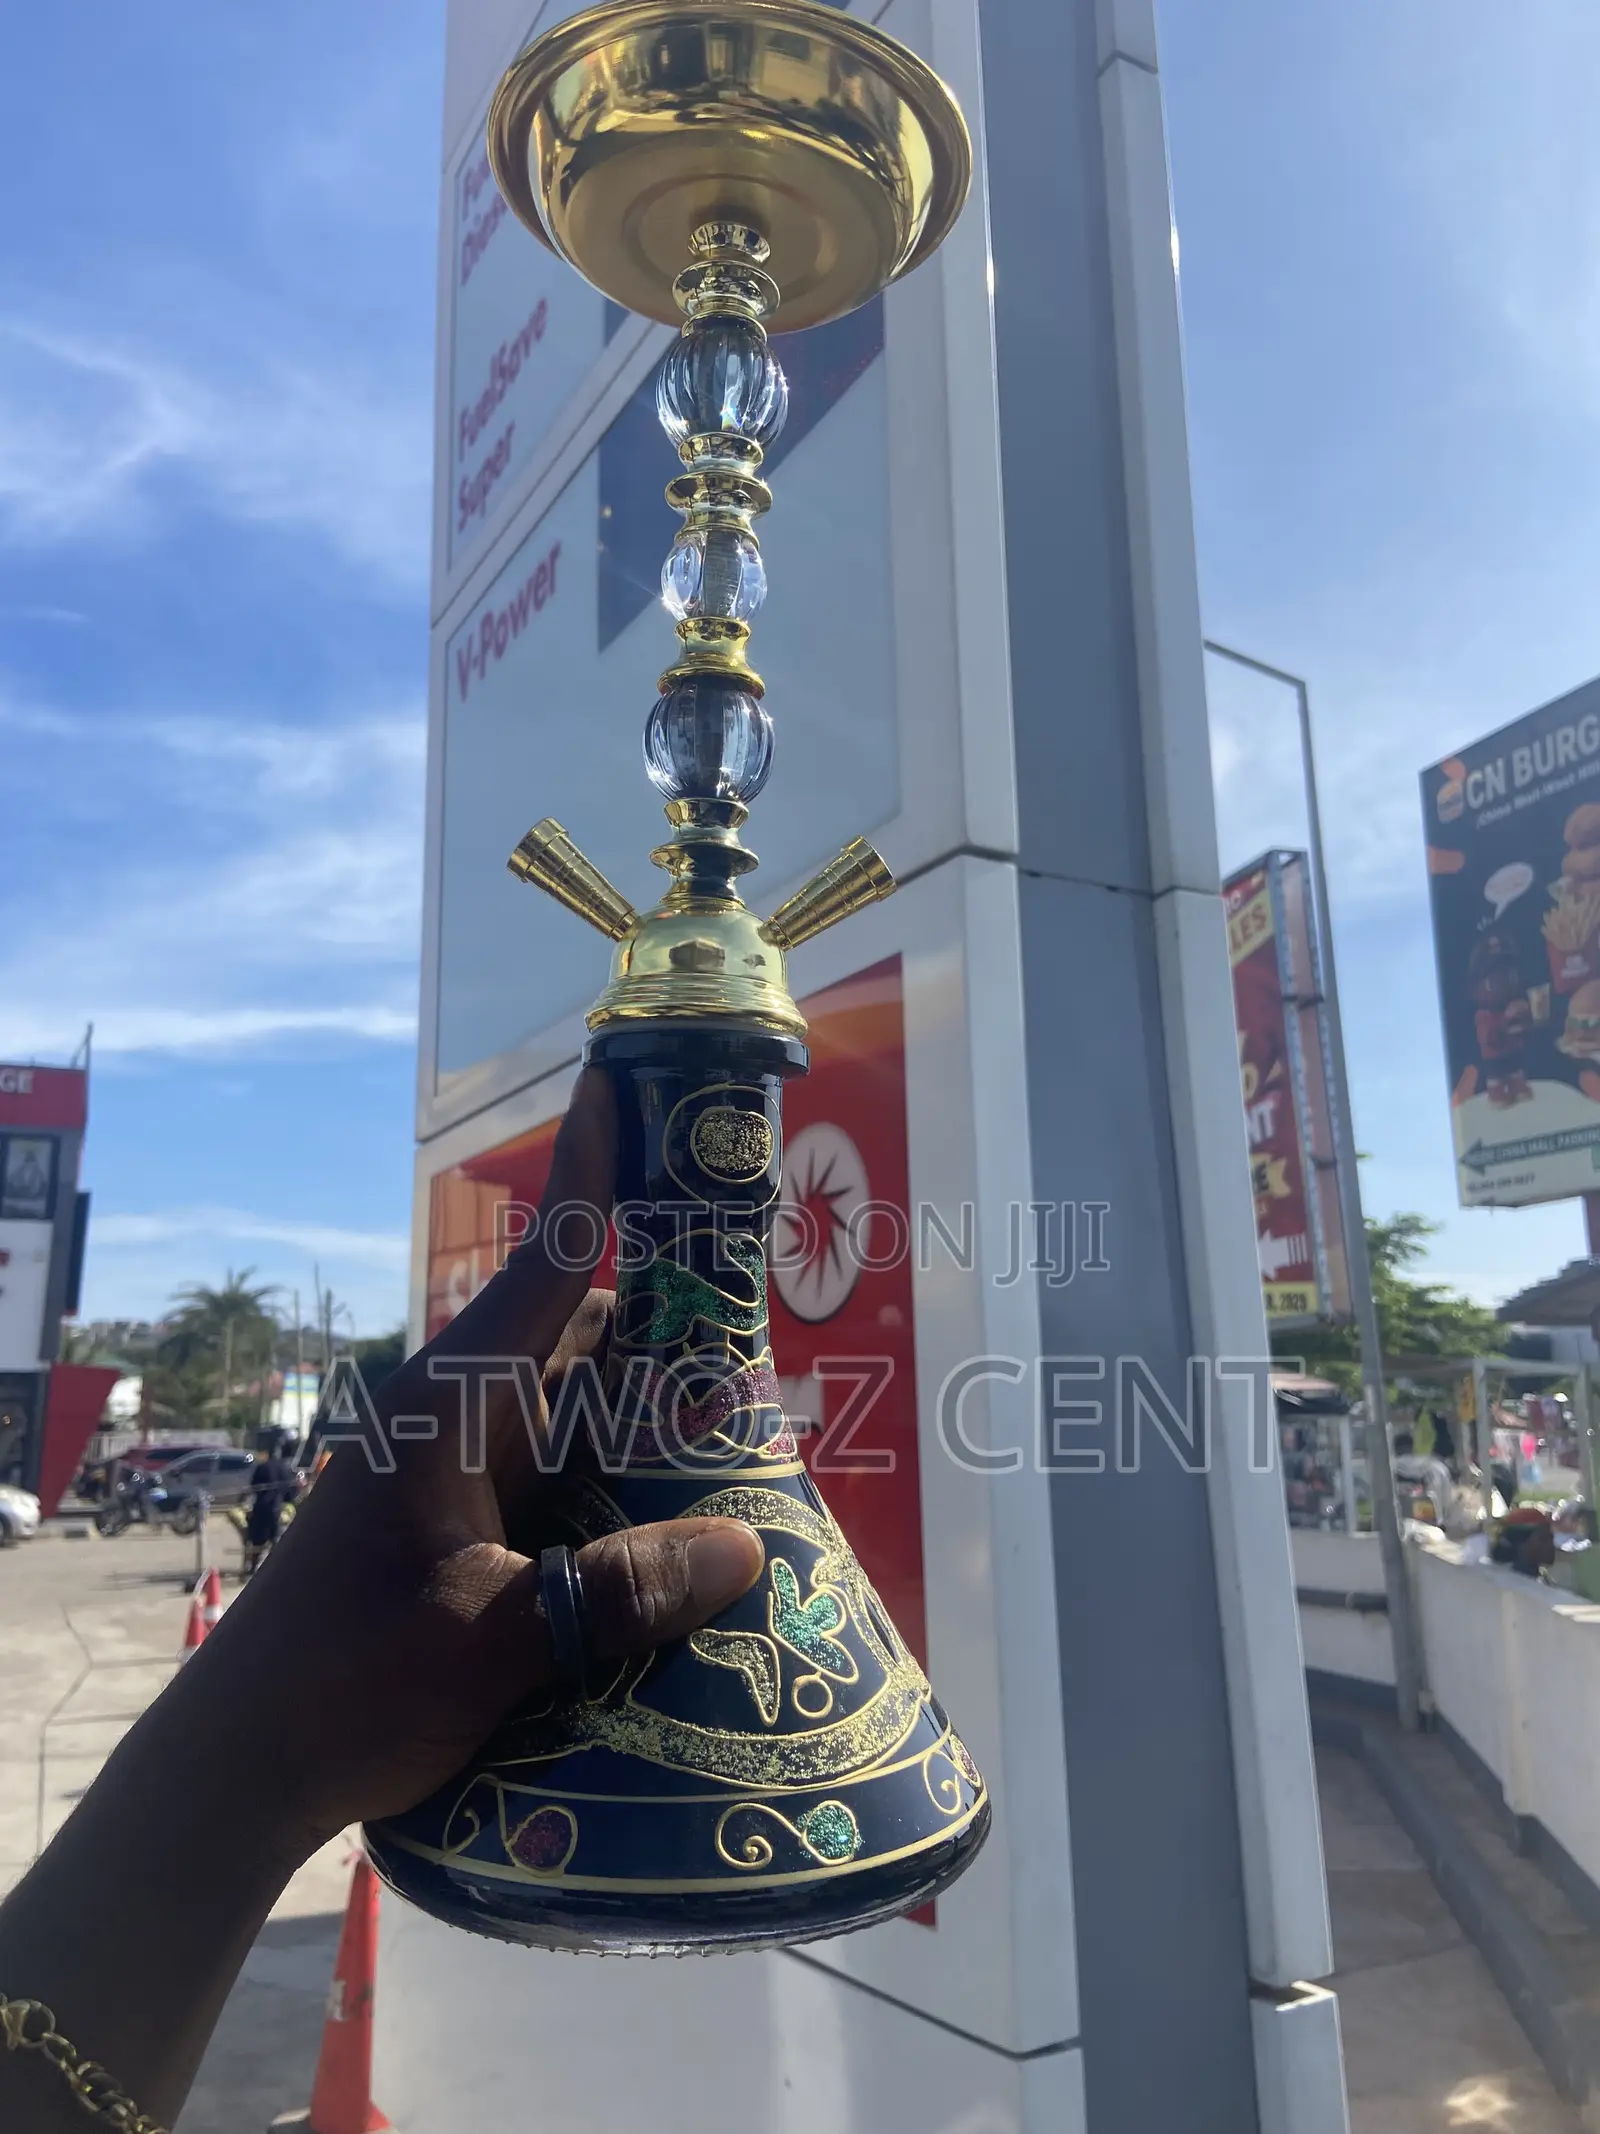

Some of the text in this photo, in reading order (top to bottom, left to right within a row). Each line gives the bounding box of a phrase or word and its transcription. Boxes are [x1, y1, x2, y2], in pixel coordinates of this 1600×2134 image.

[457, 420, 515, 534] Super
[456, 539, 561, 704] V-Power
[1466, 757, 1506, 810] CN
